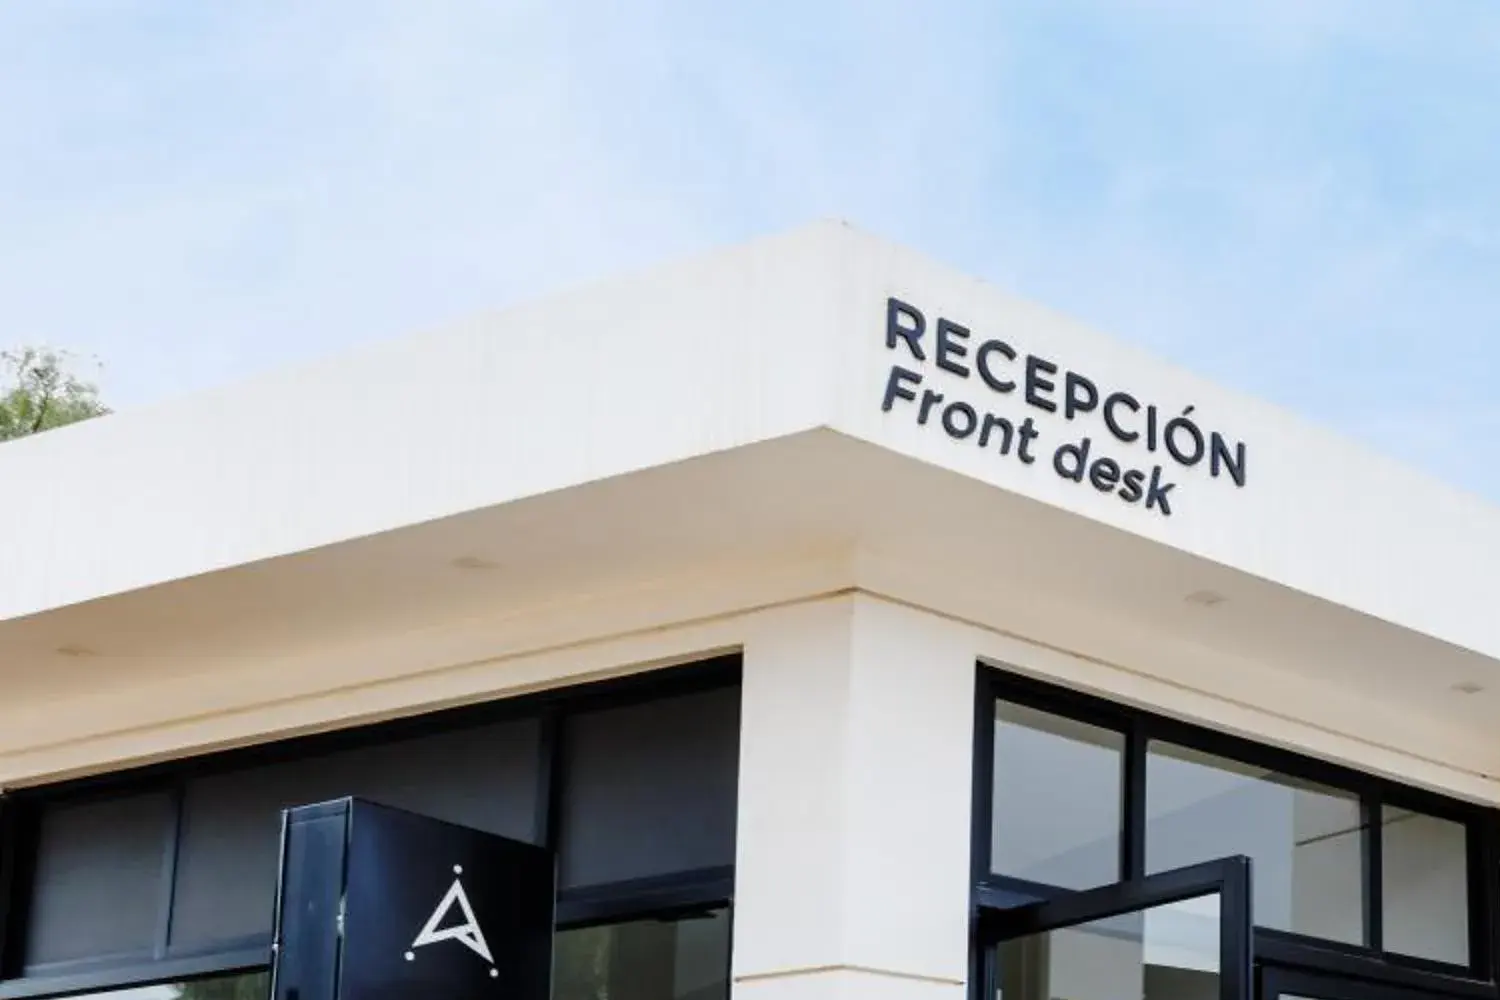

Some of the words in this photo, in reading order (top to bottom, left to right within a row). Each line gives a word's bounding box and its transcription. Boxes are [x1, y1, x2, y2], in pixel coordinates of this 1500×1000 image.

[881, 365, 1040, 465] Front
[1053, 437, 1176, 516] desk
[886, 297, 1246, 488] RECEPCIÓN
